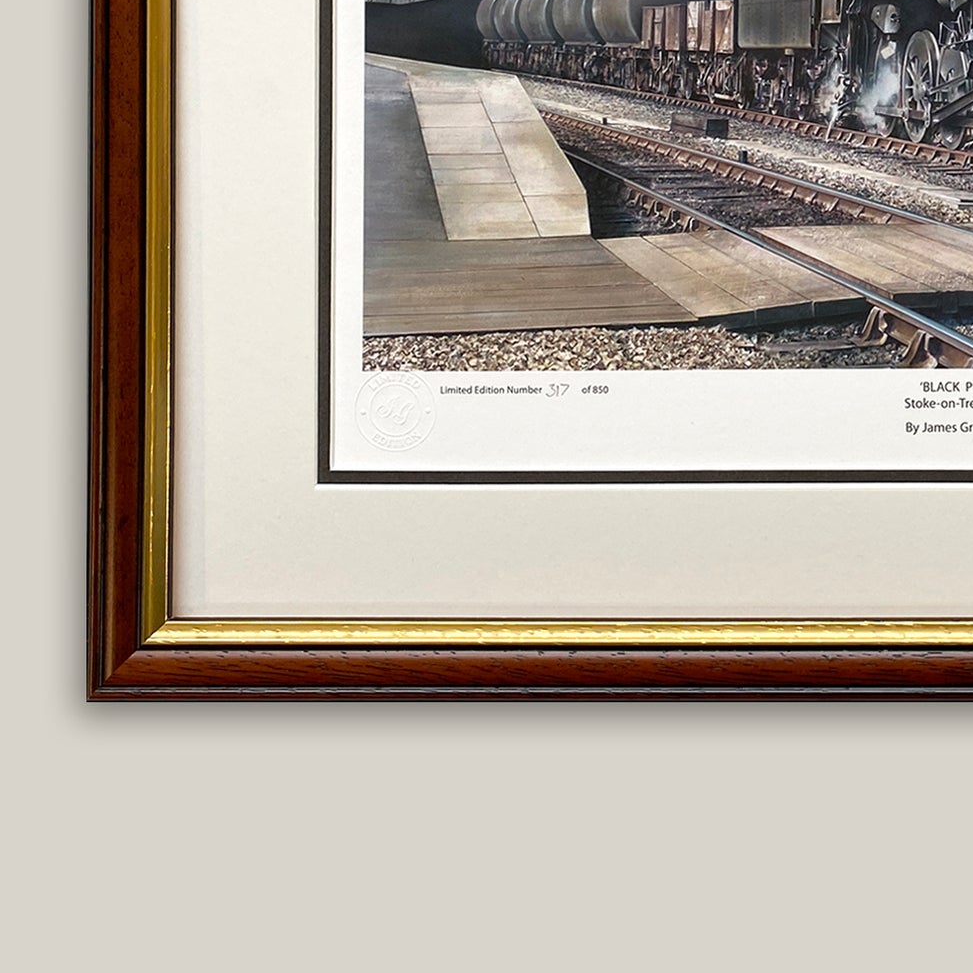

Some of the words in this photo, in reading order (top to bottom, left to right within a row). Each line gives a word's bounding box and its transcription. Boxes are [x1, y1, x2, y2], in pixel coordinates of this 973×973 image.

[439, 385, 473, 395] Limited
[474, 385, 505, 395] Edition
[507, 385, 543, 395] Number
[545, 383, 570, 398] 317
[581, 385, 592, 395] of
[592, 385, 609, 395] 850
[905, 421, 920, 436] By
[921, 422, 957, 433] James
